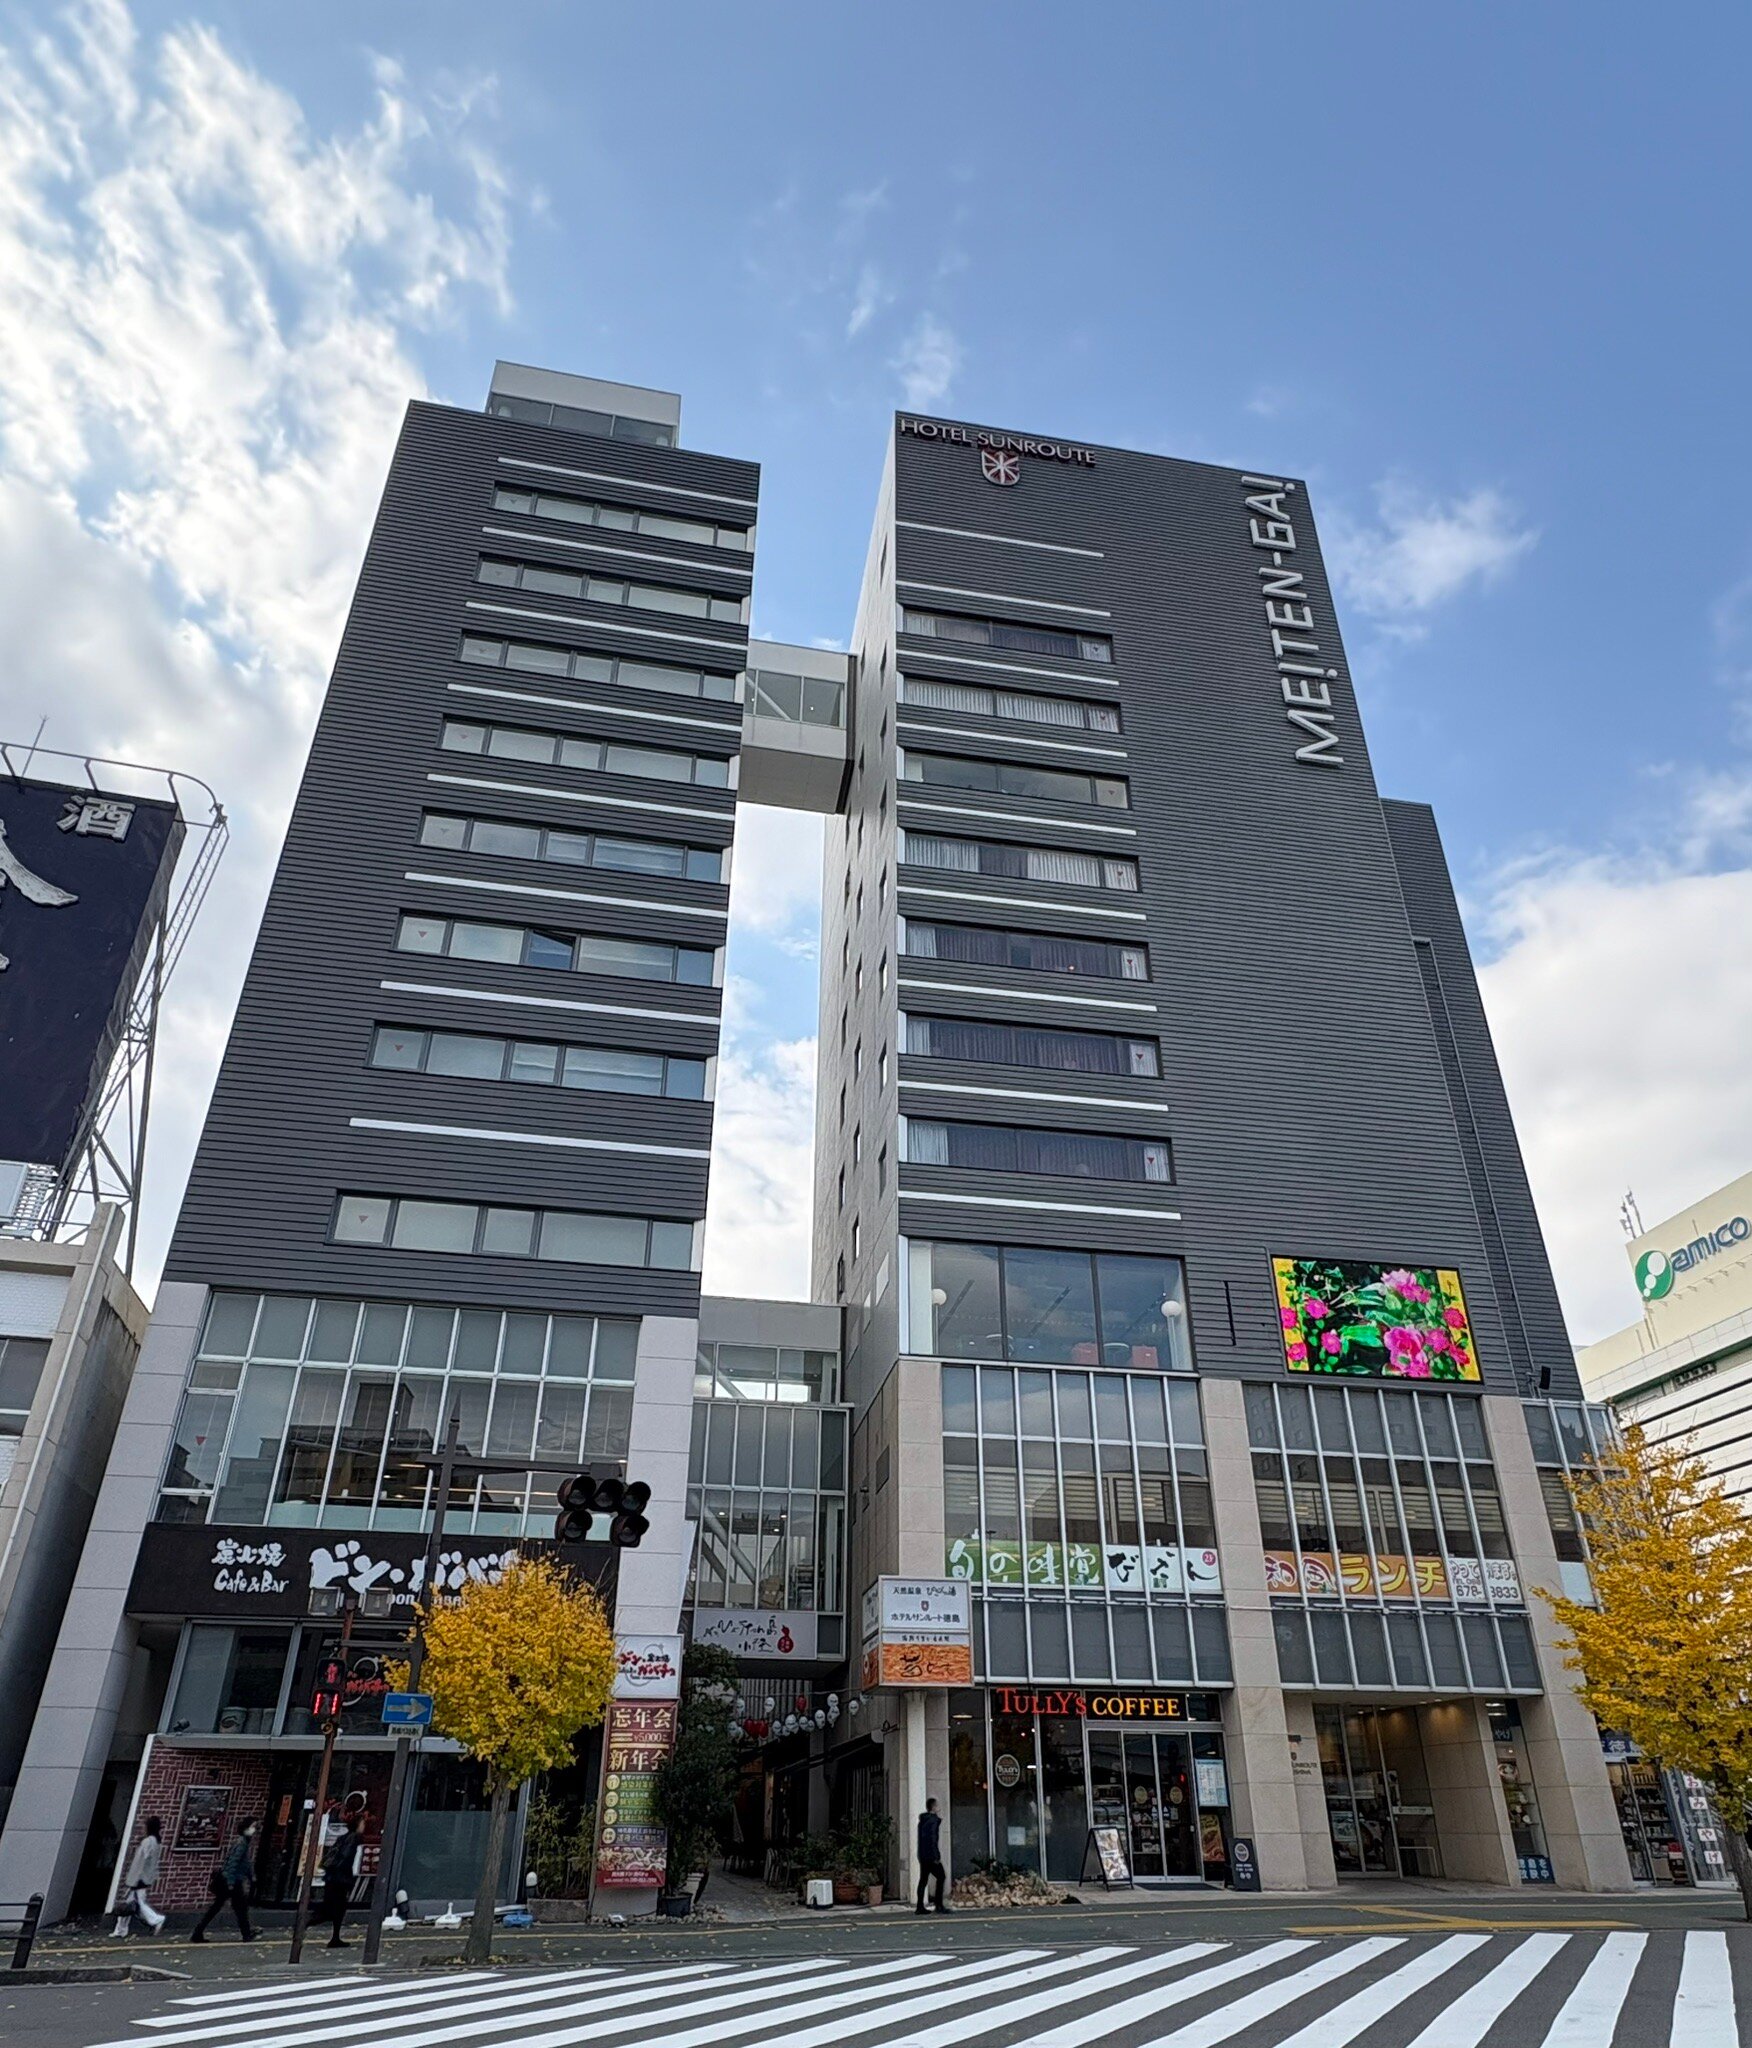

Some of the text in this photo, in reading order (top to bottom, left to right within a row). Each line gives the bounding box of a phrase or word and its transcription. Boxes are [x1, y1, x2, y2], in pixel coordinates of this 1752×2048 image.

[901, 418, 1096, 464] HOTEL SUNROUTE
[56, 795, 136, 842] 酒
[1671, 1217, 1750, 1272] amico
[211, 1538, 287, 1567] 炭火焼
[611, 1708, 672, 1729] 忘年会
[1092, 1697, 1180, 1716] COFFEE
[608, 1749, 669, 1771] 新年会
